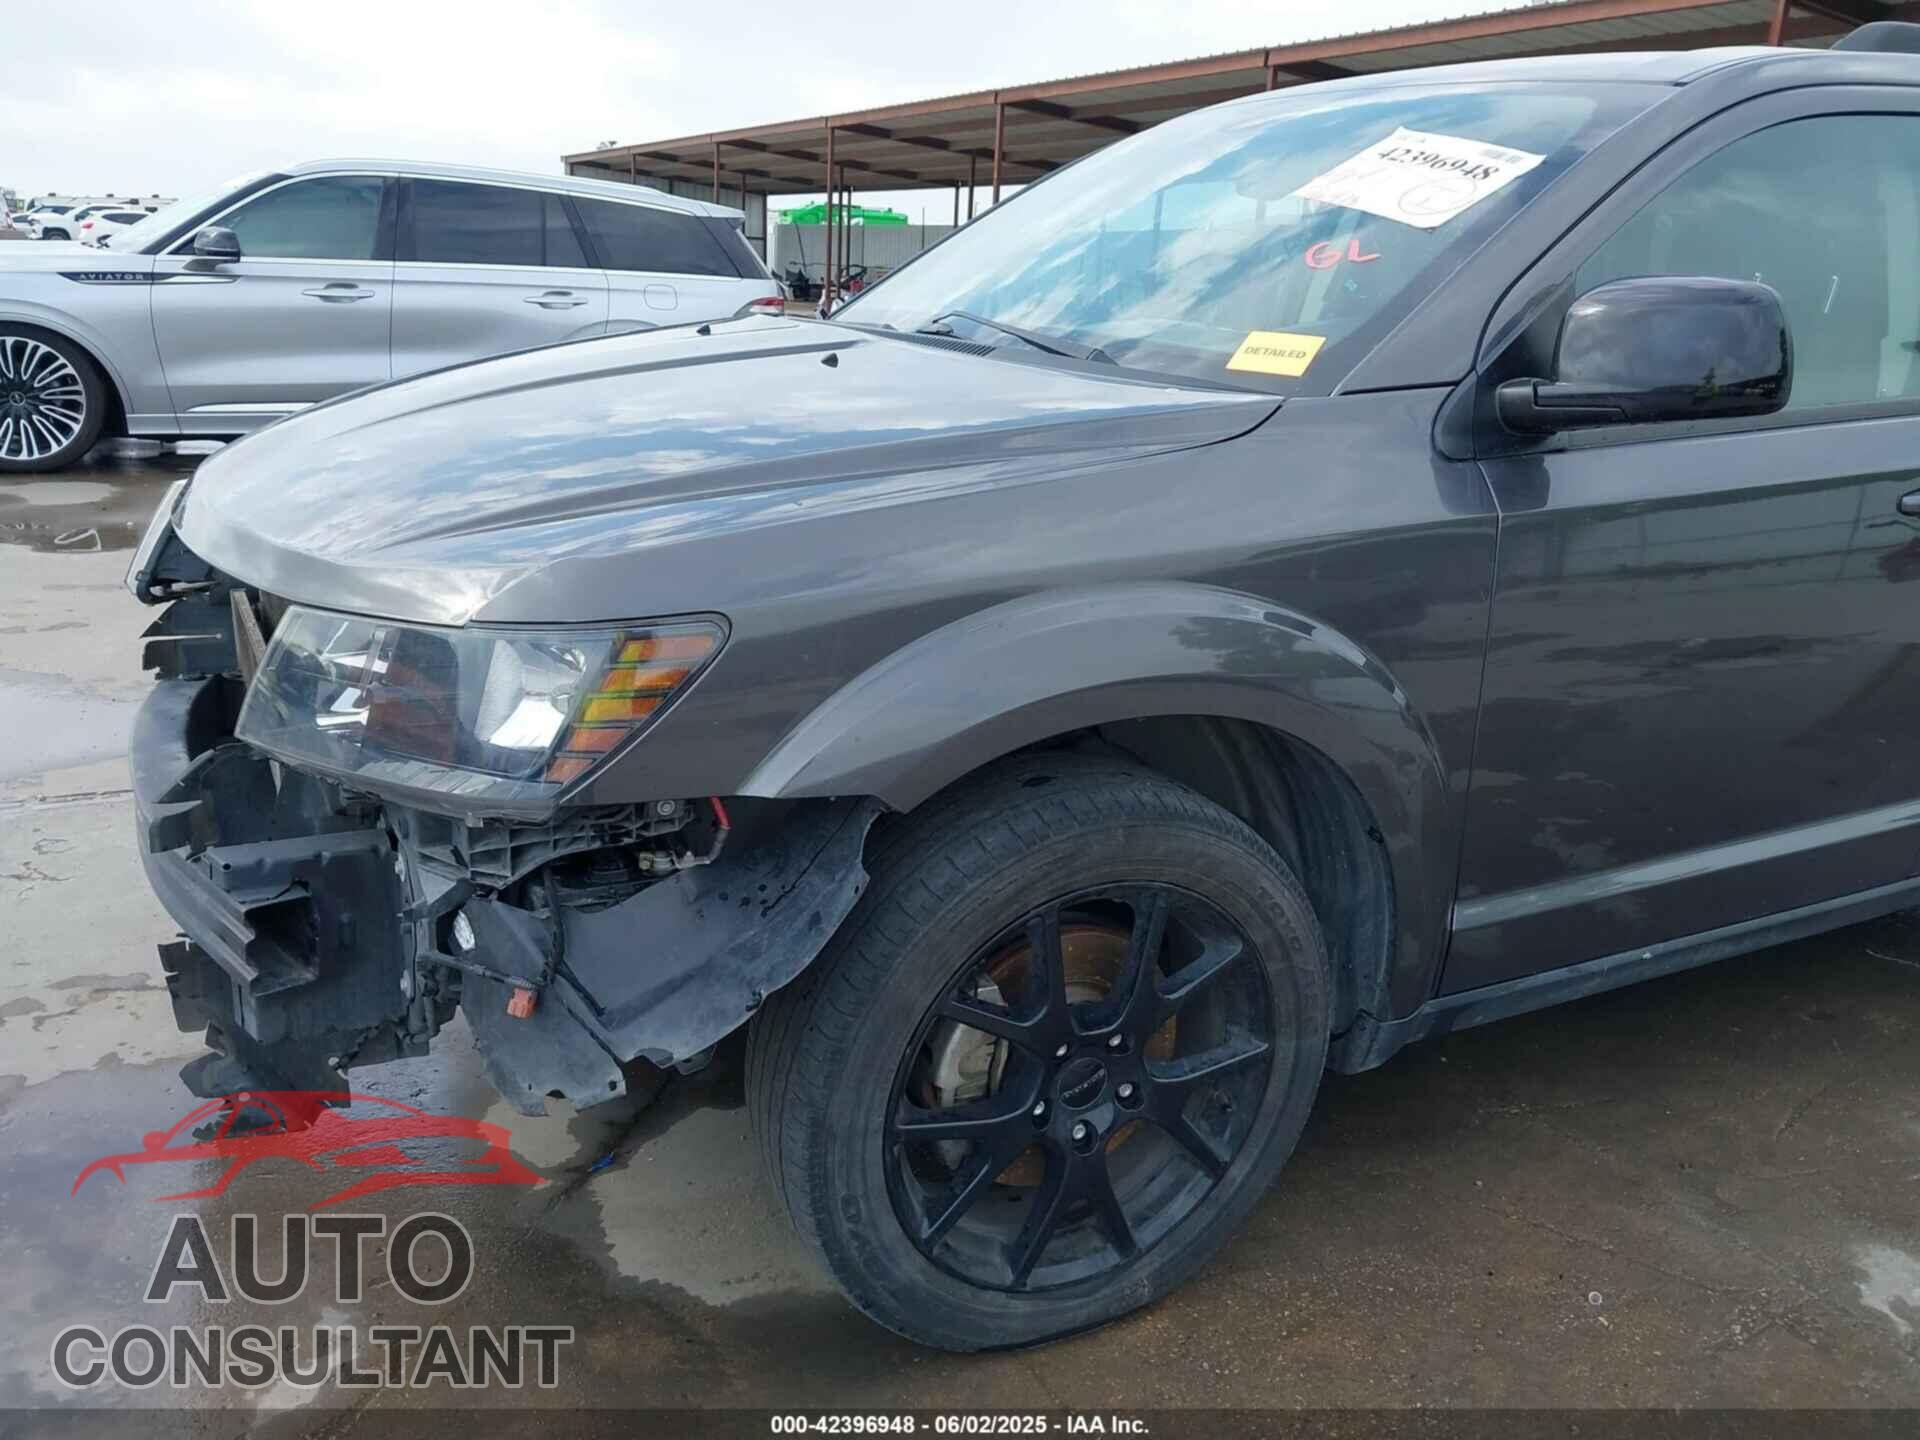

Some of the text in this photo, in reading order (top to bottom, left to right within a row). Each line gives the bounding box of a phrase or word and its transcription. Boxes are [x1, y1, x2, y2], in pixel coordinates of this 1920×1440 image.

[1378, 146, 1499, 181] 42396948
[79, 273, 145, 281] AVIATOR
[1244, 345, 1306, 359] DETAILED
